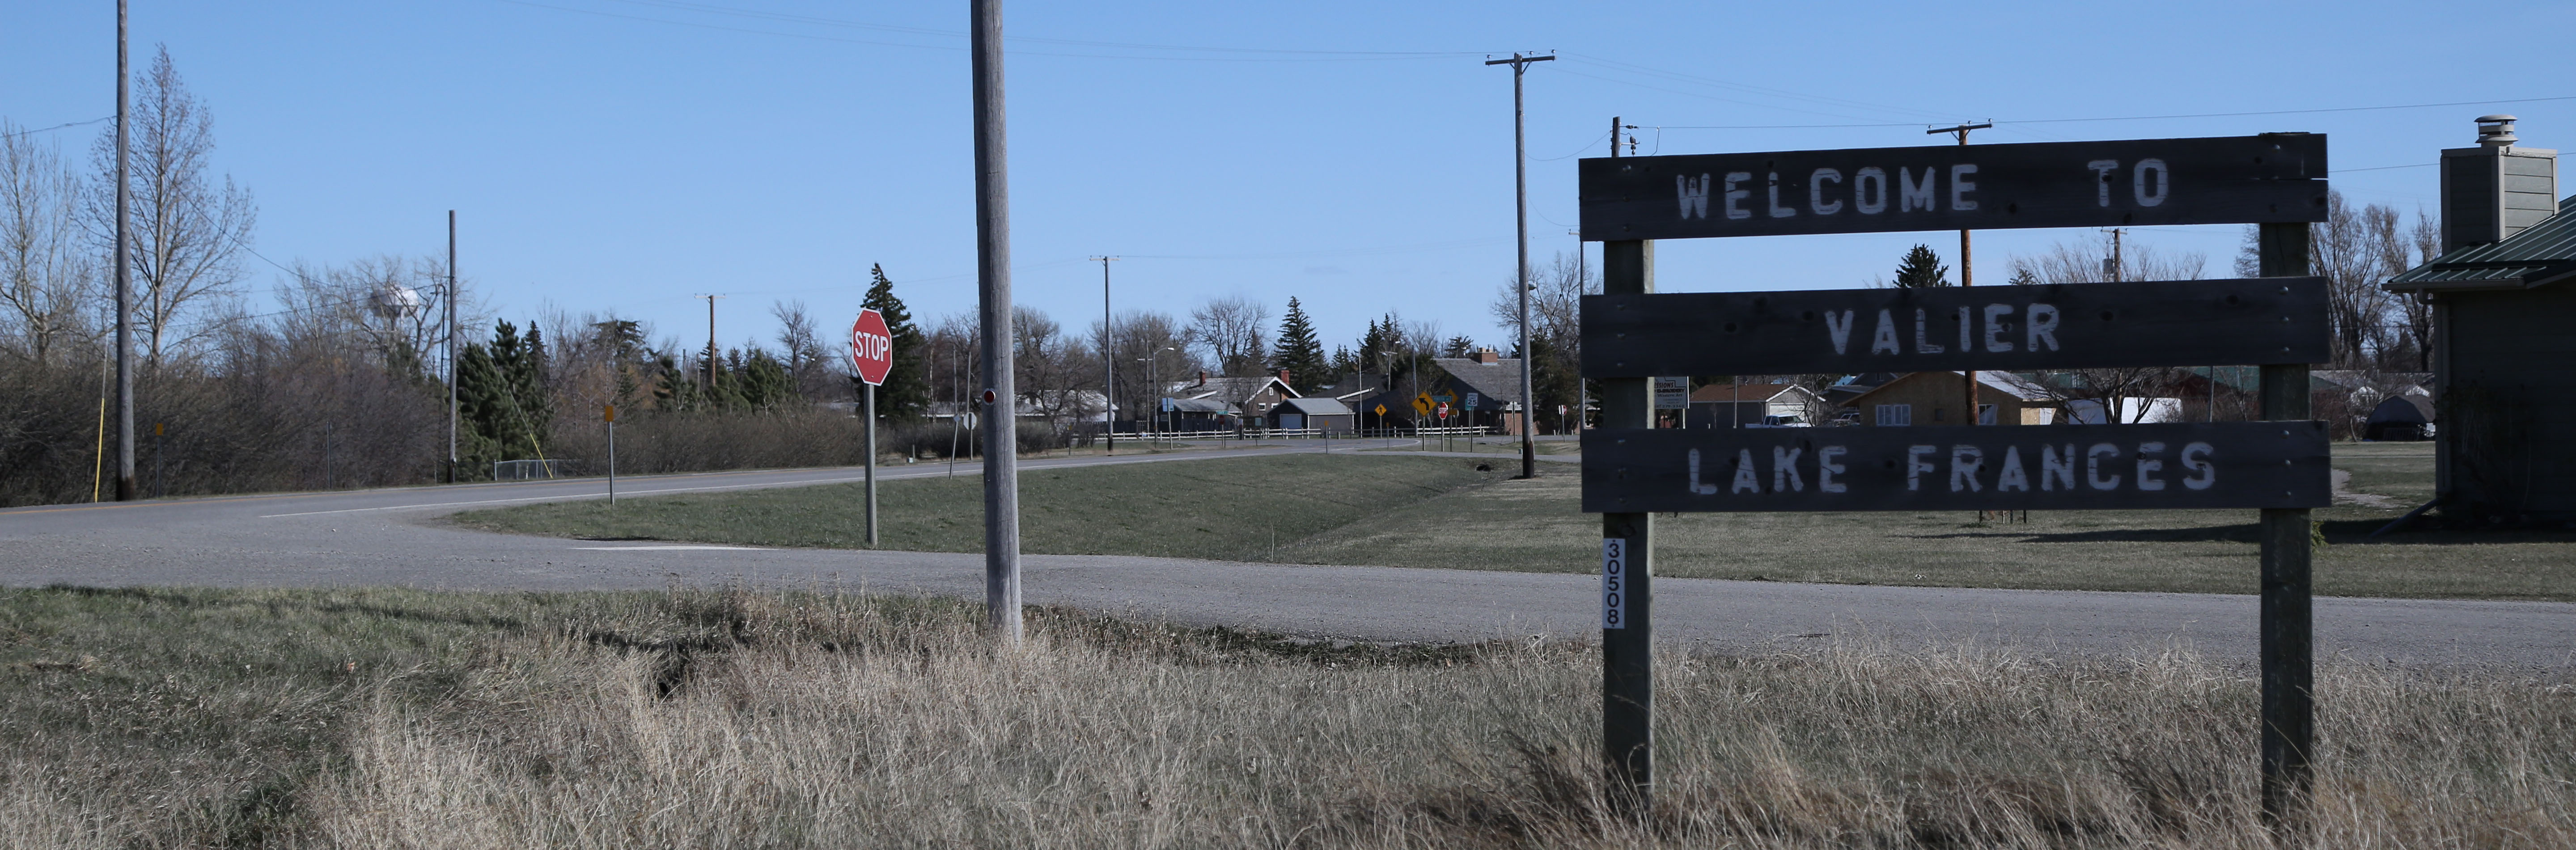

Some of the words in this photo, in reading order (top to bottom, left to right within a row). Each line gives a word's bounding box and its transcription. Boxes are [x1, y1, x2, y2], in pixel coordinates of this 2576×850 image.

[1677, 164, 1978, 219] WELCOME
[2088, 158, 2169, 207] TO
[855, 330, 889, 362] STOP
[1825, 303, 2059, 355] VALIER
[1689, 445, 1847, 494] LAKE
[1907, 442, 2216, 492] FRANCES
[1607, 543, 1620, 625] 30508
